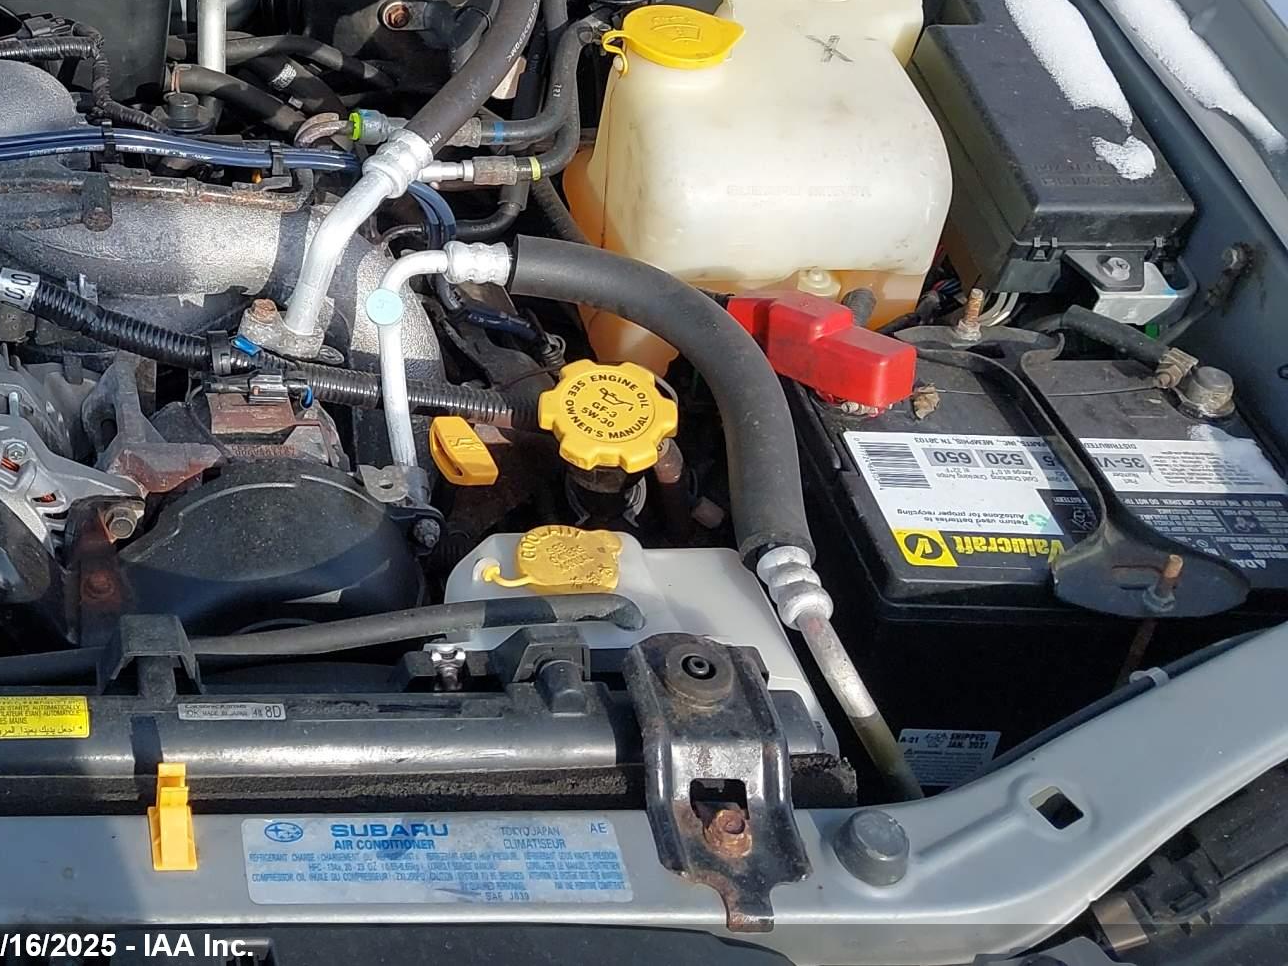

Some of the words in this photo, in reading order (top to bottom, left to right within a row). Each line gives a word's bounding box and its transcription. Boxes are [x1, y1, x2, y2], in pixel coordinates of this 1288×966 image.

[567, 379, 586, 397] SEE
[590, 373, 638, 392] ENGINE
[636, 392, 650, 409] OIL
[591, 401, 618, 418] GF-3
[565, 399, 604, 438] OWNER'S
[608, 414, 650, 440] MANUAL
[580, 406, 616, 428] 5W-30
[952, 436, 993, 446] MEMPHIS,
[933, 450, 972, 464] 650
[985, 451, 1024, 465] 520
[936, 471, 956, 479] Amps
[958, 471, 988, 480] Cranking
[990, 472, 1022, 481] Cranking
[896, 508, 936, 517] recycling
[937, 510, 966, 518] proper
[975, 518, 996, 526] used
[999, 518, 1028, 526] Return
[952, 535, 1065, 565] Valucraft
[265, 705, 282, 718] 8D
[330, 823, 449, 837] SUBARU
[500, 826, 530, 836] TOKYO
[531, 826, 561, 836] JAPAN
[590, 822, 608, 834] AE
[334, 840, 354, 850] AIR
[356, 839, 435, 850] CONDITIONER
[503, 838, 567, 850] CLIMATISEUR
